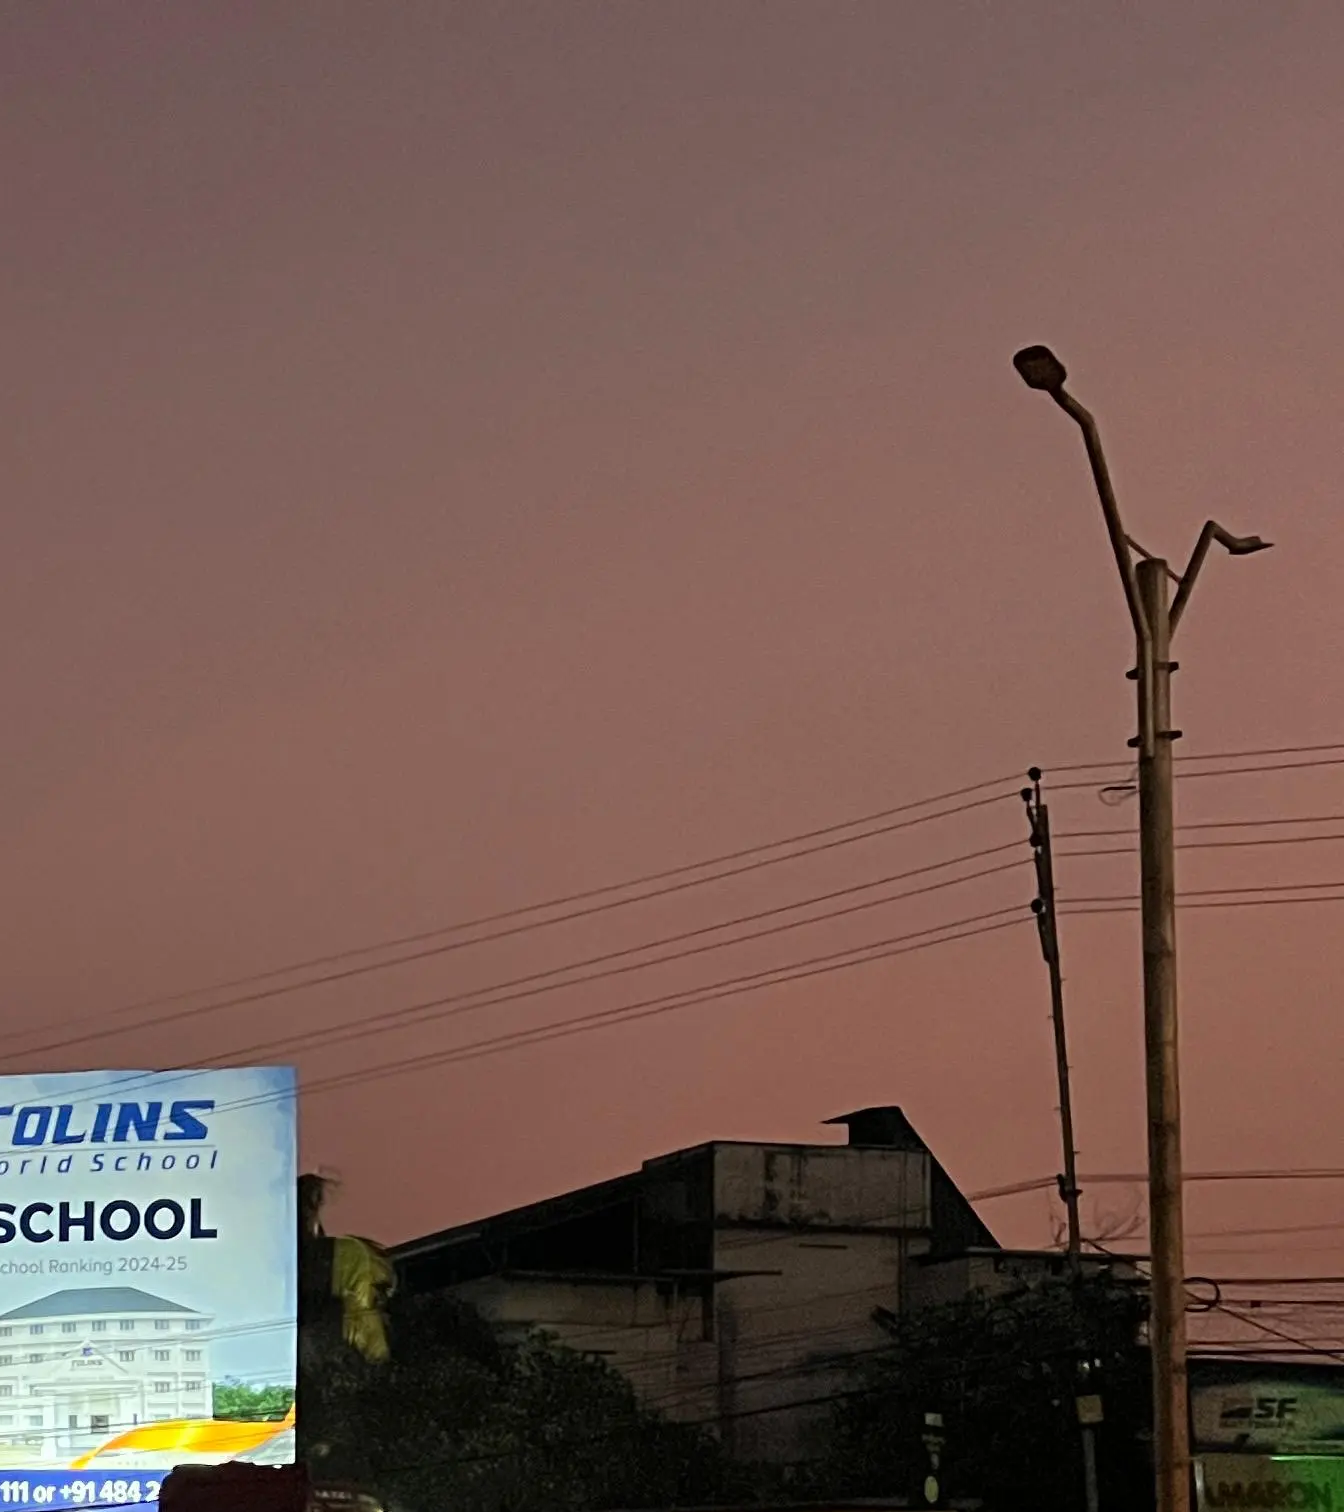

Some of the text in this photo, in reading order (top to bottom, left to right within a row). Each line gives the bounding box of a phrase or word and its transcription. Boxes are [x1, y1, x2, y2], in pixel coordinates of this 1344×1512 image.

[90, 1150, 218, 1173] School
[48, 1258, 113, 1275] Ranking
[118, 1255, 189, 1272] 2024-25
[0, 1480, 29, 1503] 111
[33, 1485, 57, 1503] or
[60, 1481, 96, 1503] +91
[100, 1480, 142, 1503] 484
